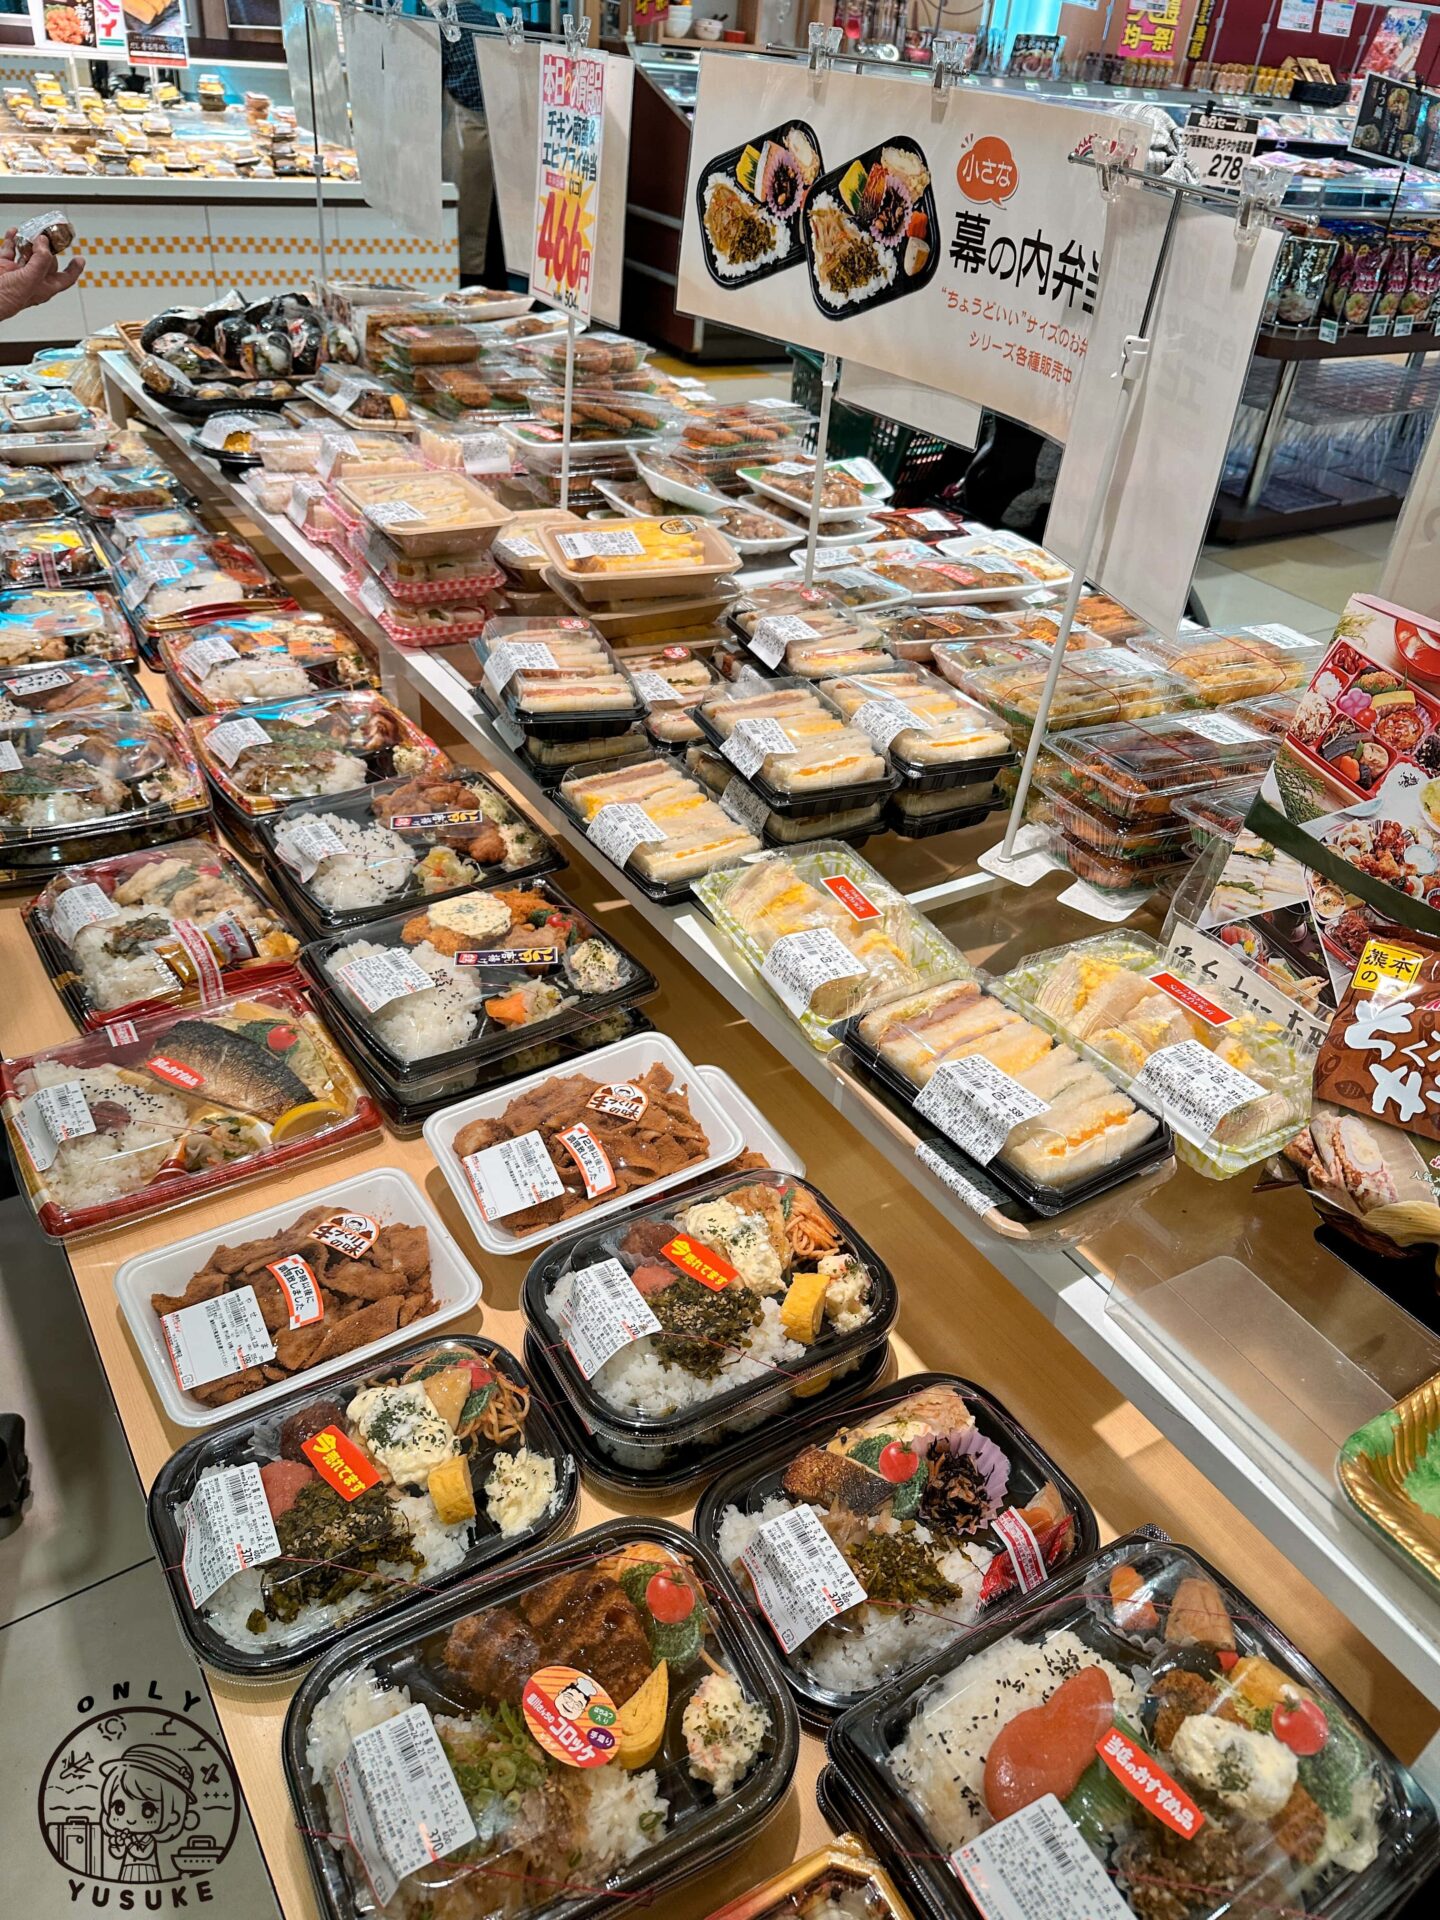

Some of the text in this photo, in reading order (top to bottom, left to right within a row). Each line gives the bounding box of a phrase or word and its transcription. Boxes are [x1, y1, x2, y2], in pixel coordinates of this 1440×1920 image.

[542, 142, 598, 182] エビフライ弁当
[961, 153, 1013, 188] 小さな
[1208, 154, 1244, 181] 278
[538, 191, 591, 295] 466円
[968, 333, 1073, 385] シリーズ各種販売中
[1363, 948, 1413, 974] 熊本
[1008, 1104, 1024, 1118] 339
[1369, 1063, 1440, 1122] サ
[671, 1239, 729, 1287] 今売れてます
[245, 1297, 268, 1350] やせうま
[628, 1322, 640, 1336] 370
[312, 1432, 367, 1494] 今売れてます
[241, 1548, 254, 1564] 370
[828, 1591, 844, 1609] 370
[1104, 1734, 1195, 1832] 当店のおすすめ品
[425, 1828, 445, 1853] 370
